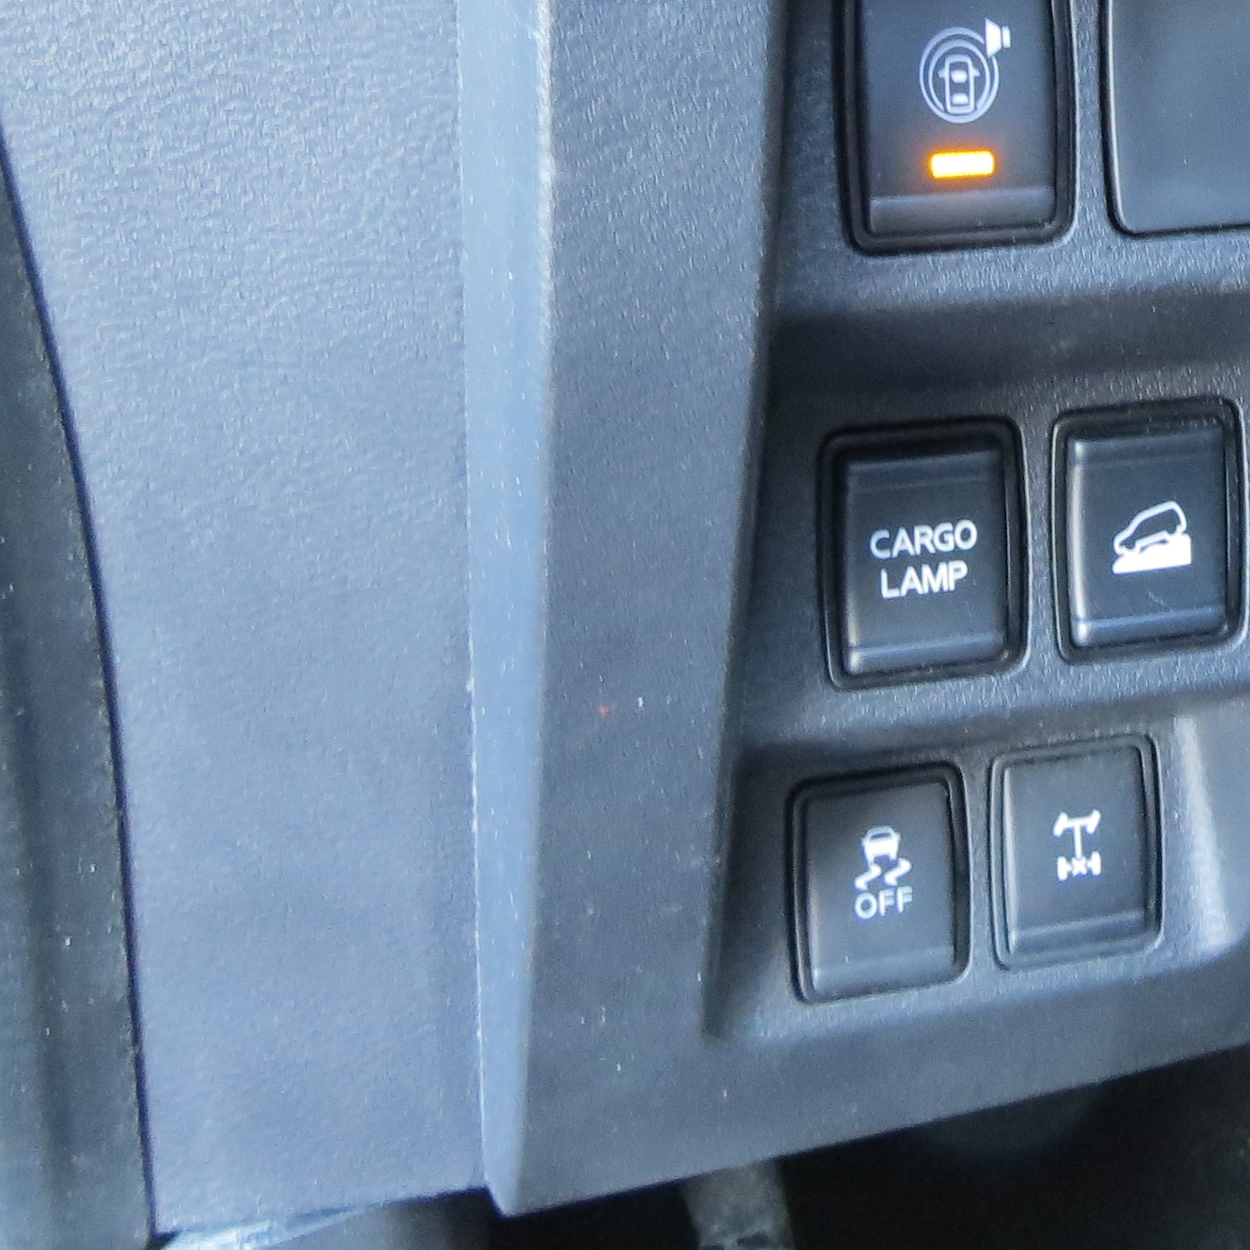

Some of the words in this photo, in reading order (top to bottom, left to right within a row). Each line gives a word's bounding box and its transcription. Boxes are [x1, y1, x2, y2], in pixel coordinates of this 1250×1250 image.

[869, 519, 979, 559] CARGO
[879, 560, 969, 599] LAMP
[854, 886, 914, 919] OFF
